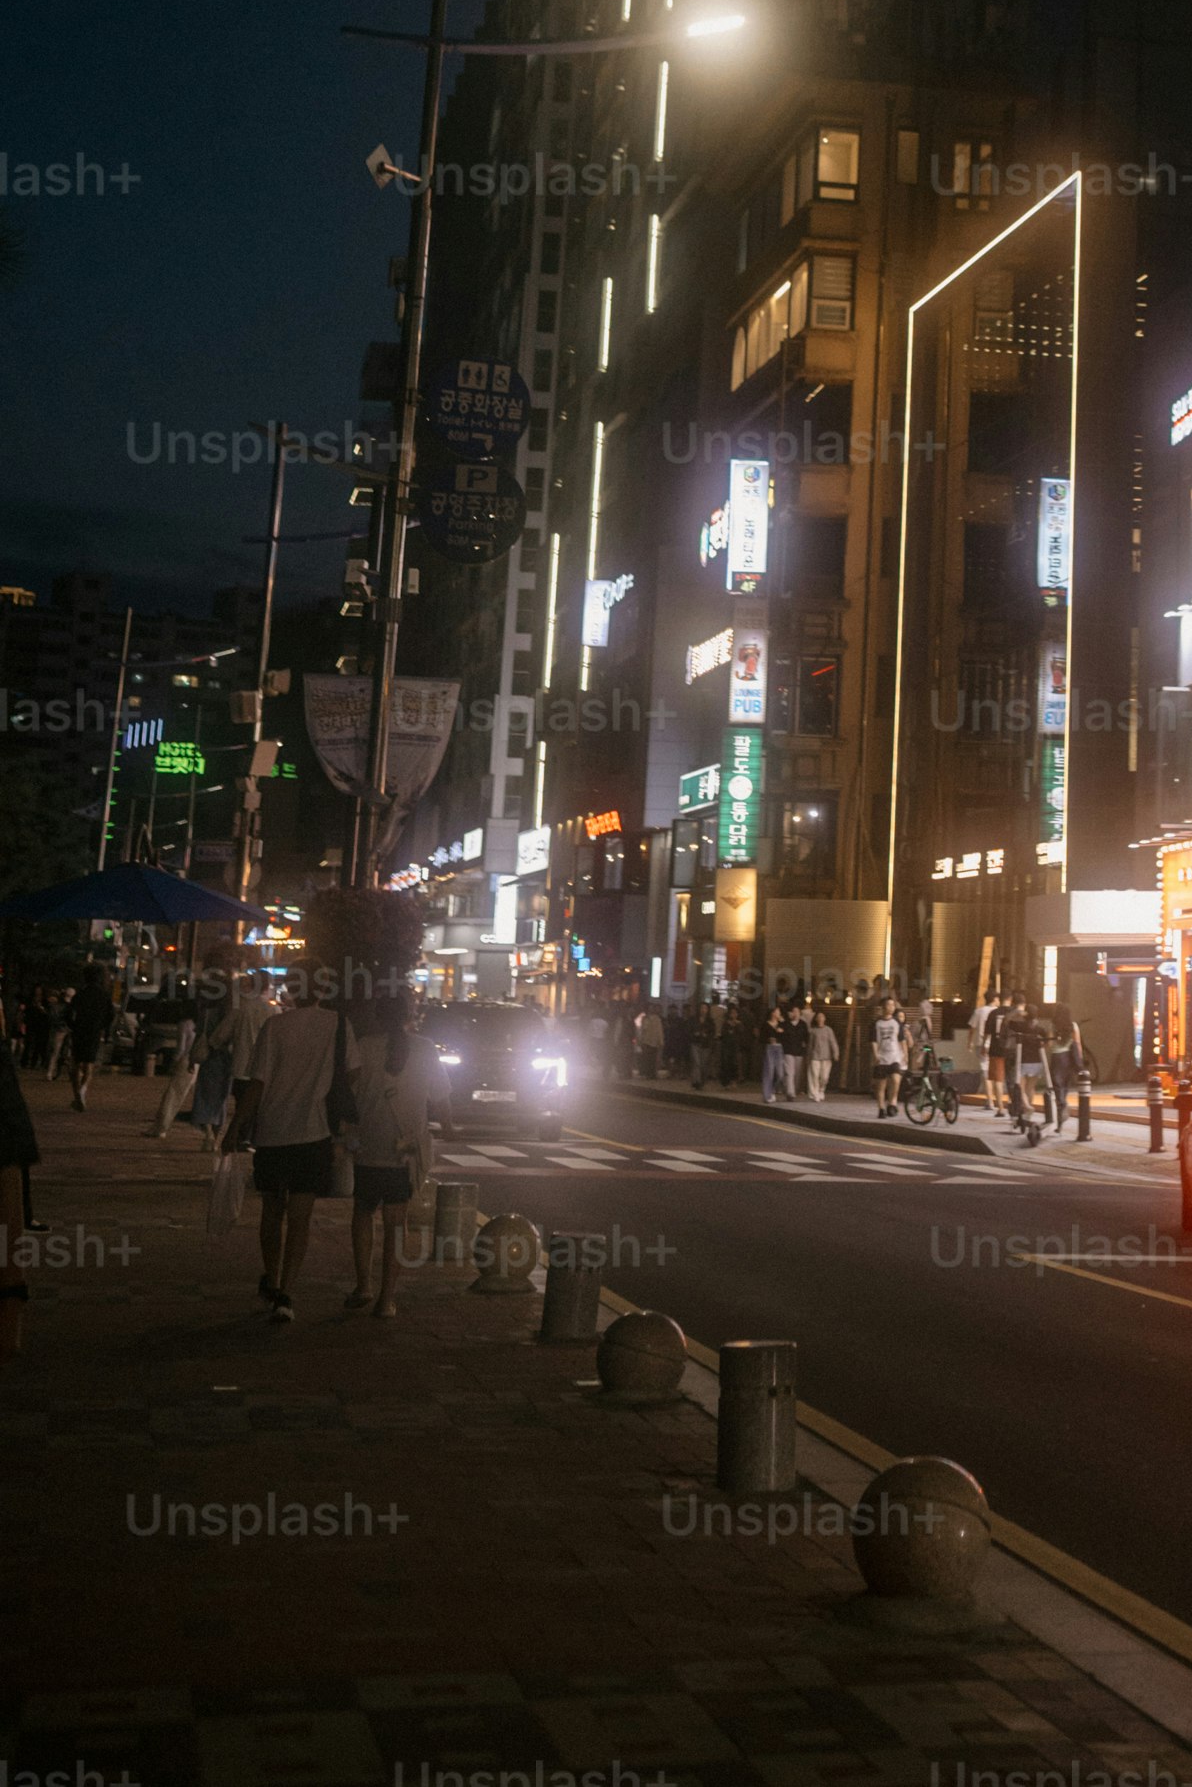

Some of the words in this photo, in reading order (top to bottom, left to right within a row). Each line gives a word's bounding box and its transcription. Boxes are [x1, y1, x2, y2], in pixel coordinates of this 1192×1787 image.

[440, 390, 523, 420] 공중화장실
[468, 469, 488, 488] P
[432, 492, 518, 521] 공영주차장
[740, 580, 757, 593] 4F
[735, 687, 761, 698] LOUNGE
[733, 698, 761, 714] PUB
